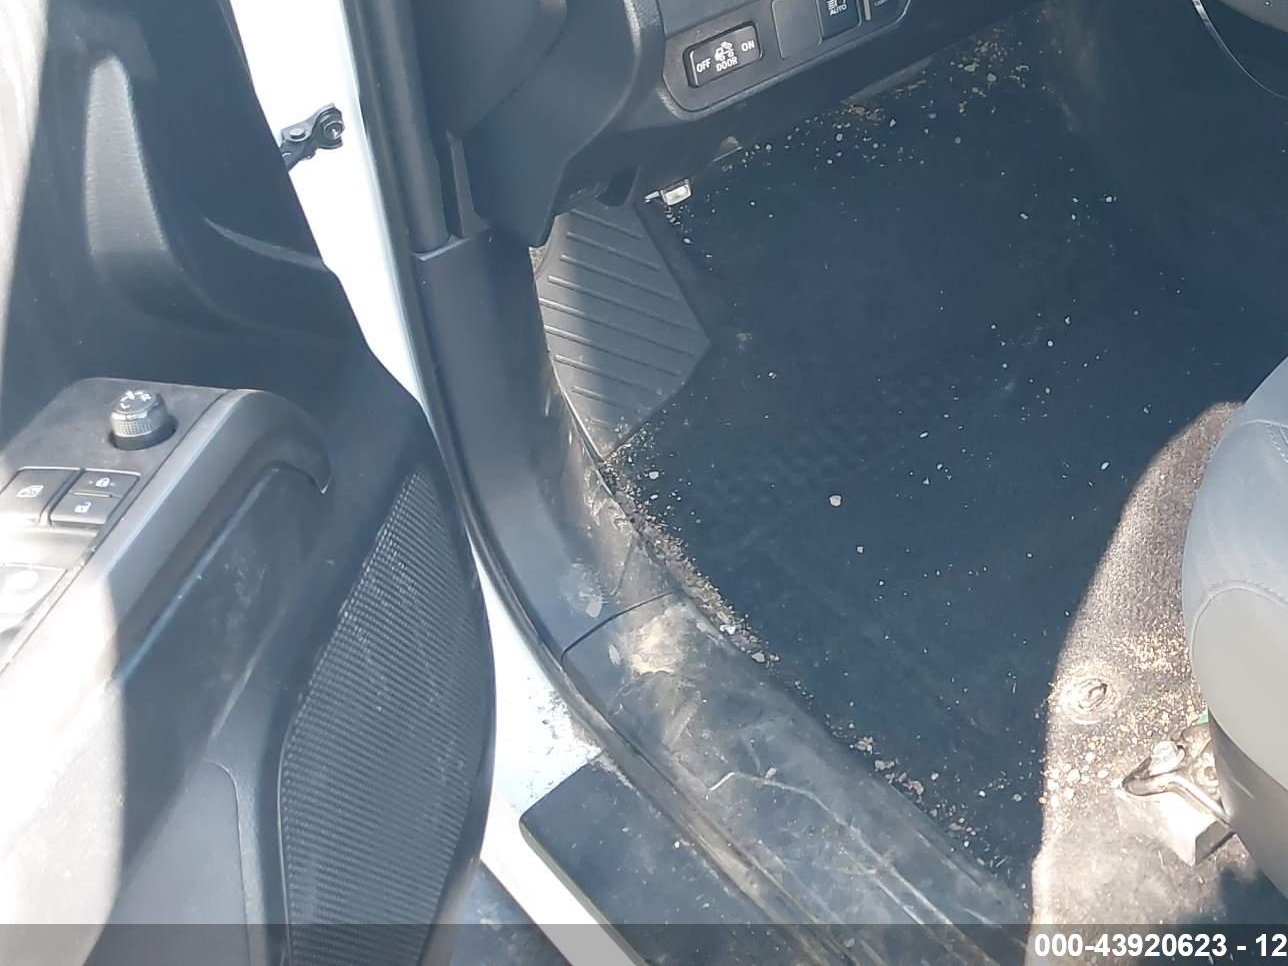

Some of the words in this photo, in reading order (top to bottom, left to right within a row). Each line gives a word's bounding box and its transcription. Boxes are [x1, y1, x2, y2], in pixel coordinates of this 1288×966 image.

[829, 3, 847, 16] AUTO
[696, 58, 712, 73] OFF
[741, 40, 755, 52] ON
[716, 57, 738, 71] DOOR
